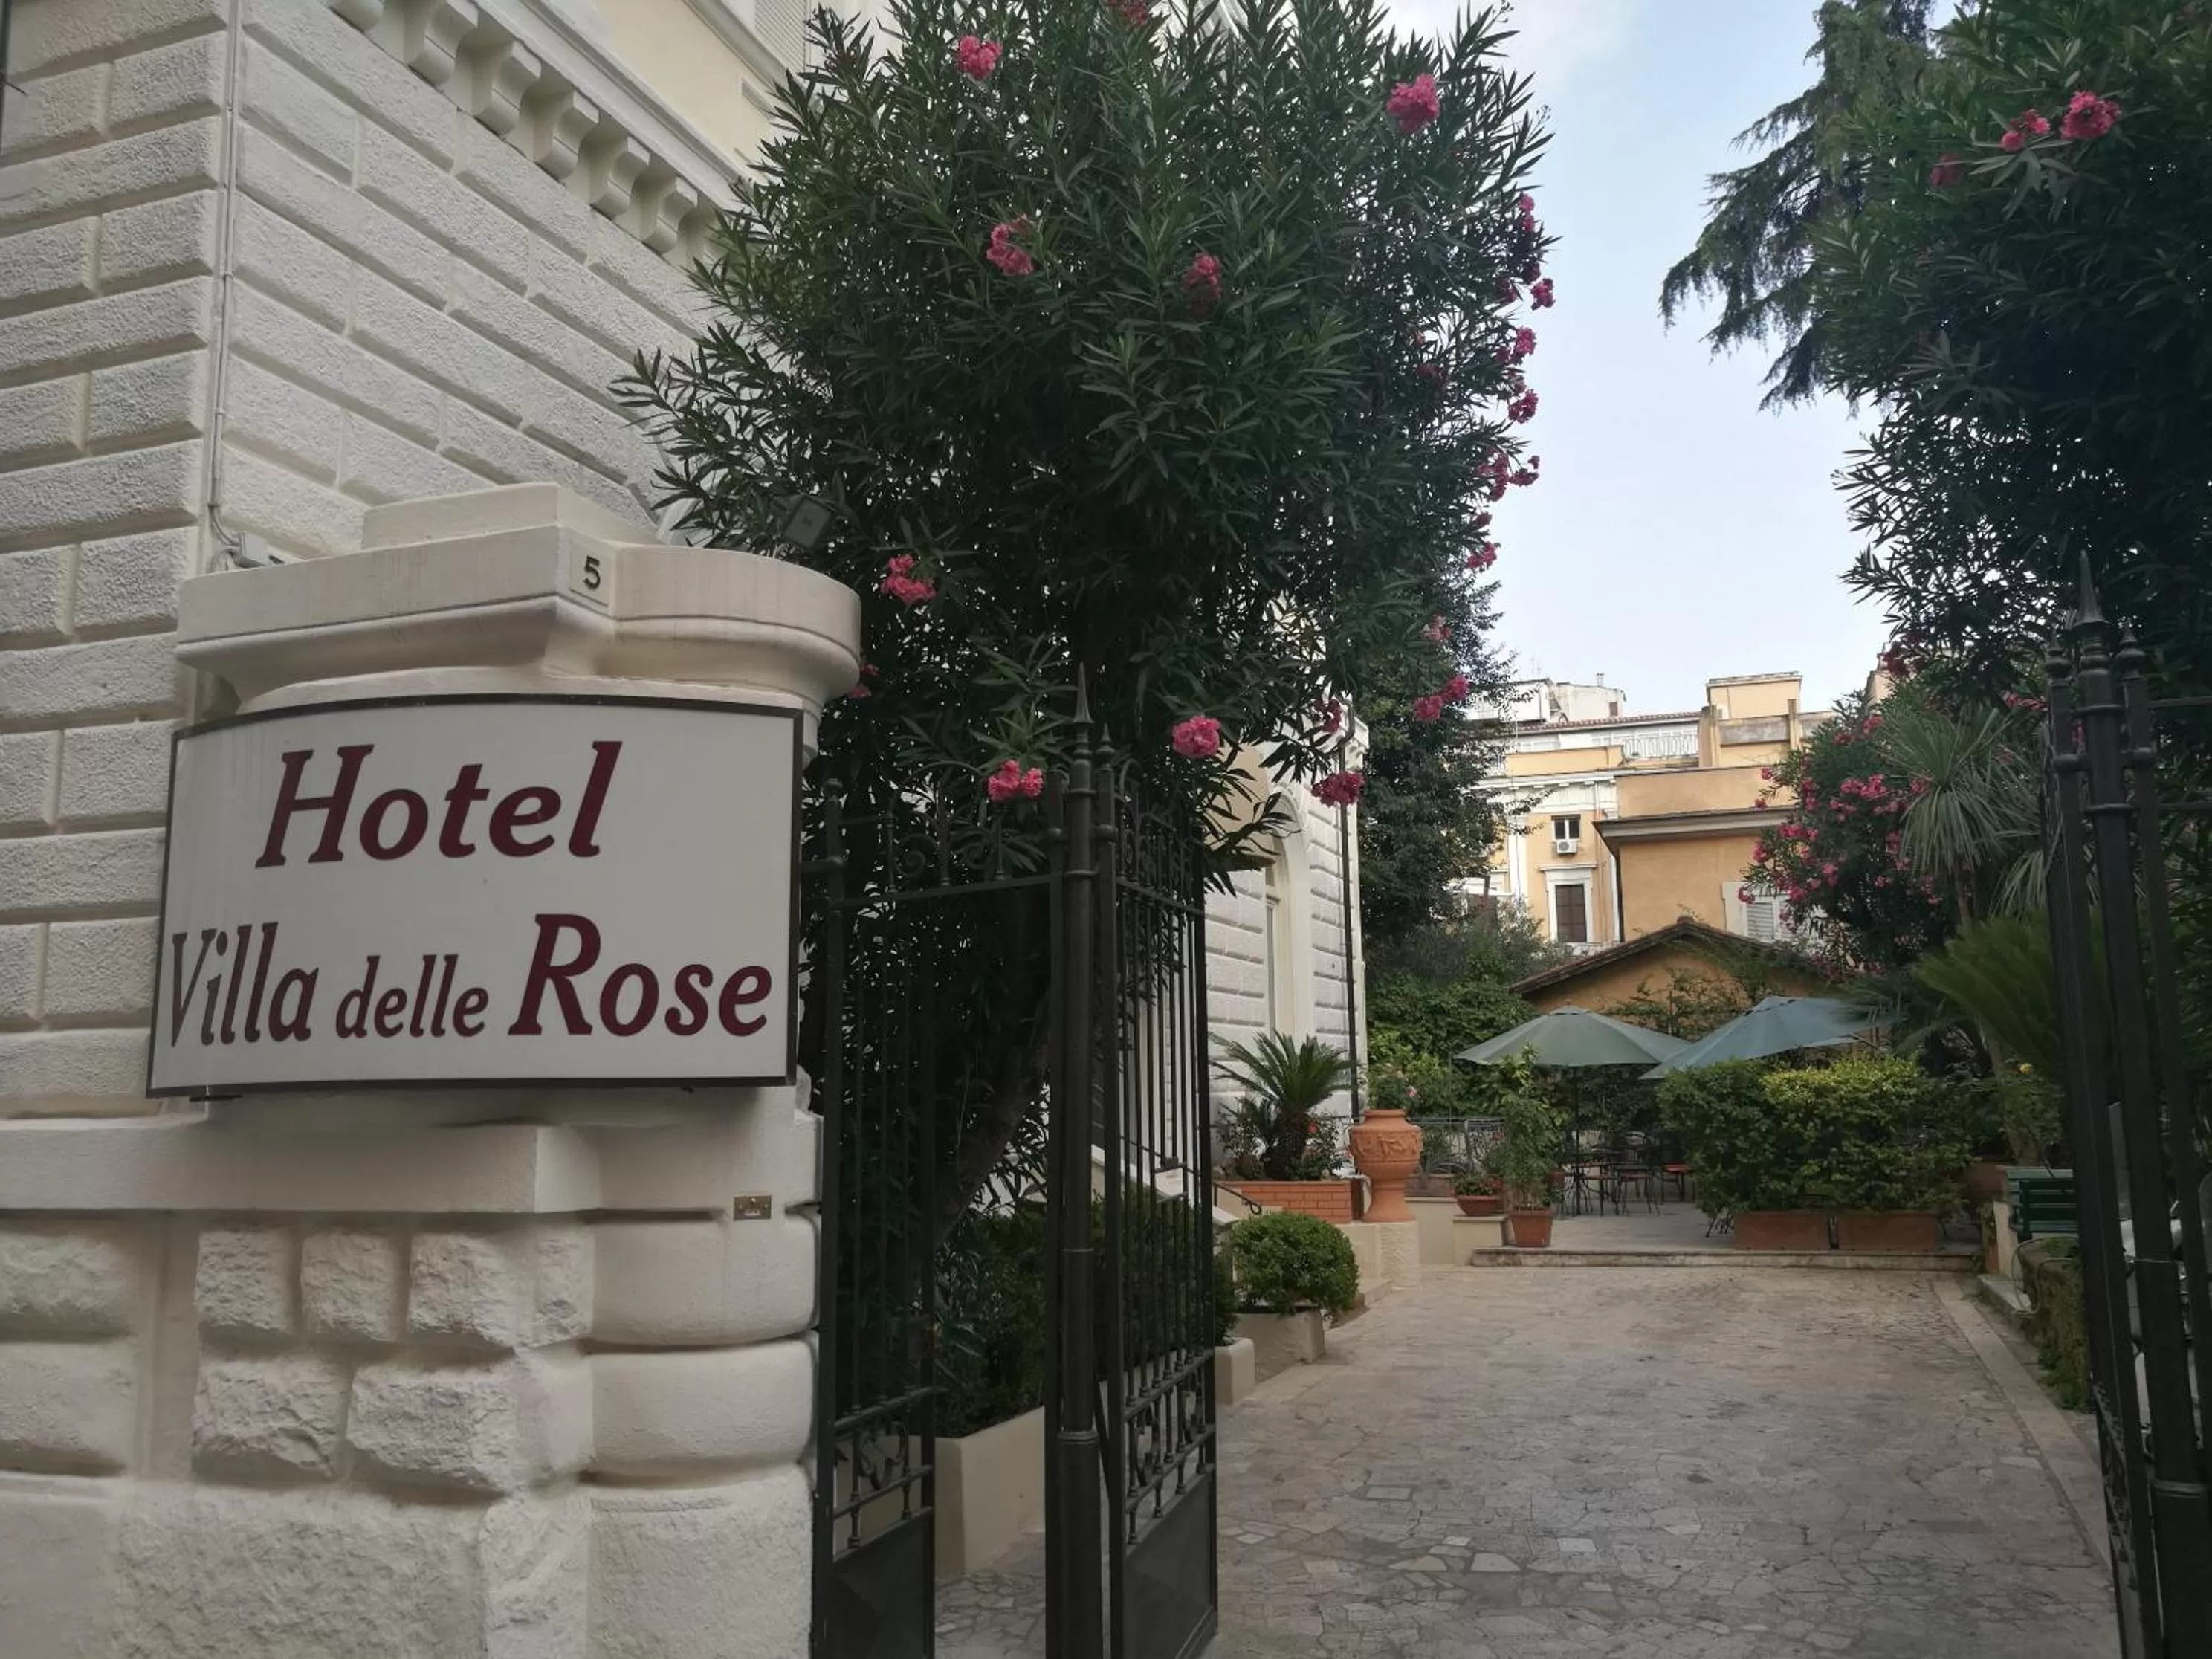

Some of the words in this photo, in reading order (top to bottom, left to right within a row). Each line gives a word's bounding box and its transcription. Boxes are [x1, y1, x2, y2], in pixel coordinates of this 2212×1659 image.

[583, 554, 601, 591] 5
[255, 740, 623, 869] Hotel
[171, 922, 320, 1047] Villa
[335, 954, 490, 1039] delle
[508, 913, 773, 1038] Rose
